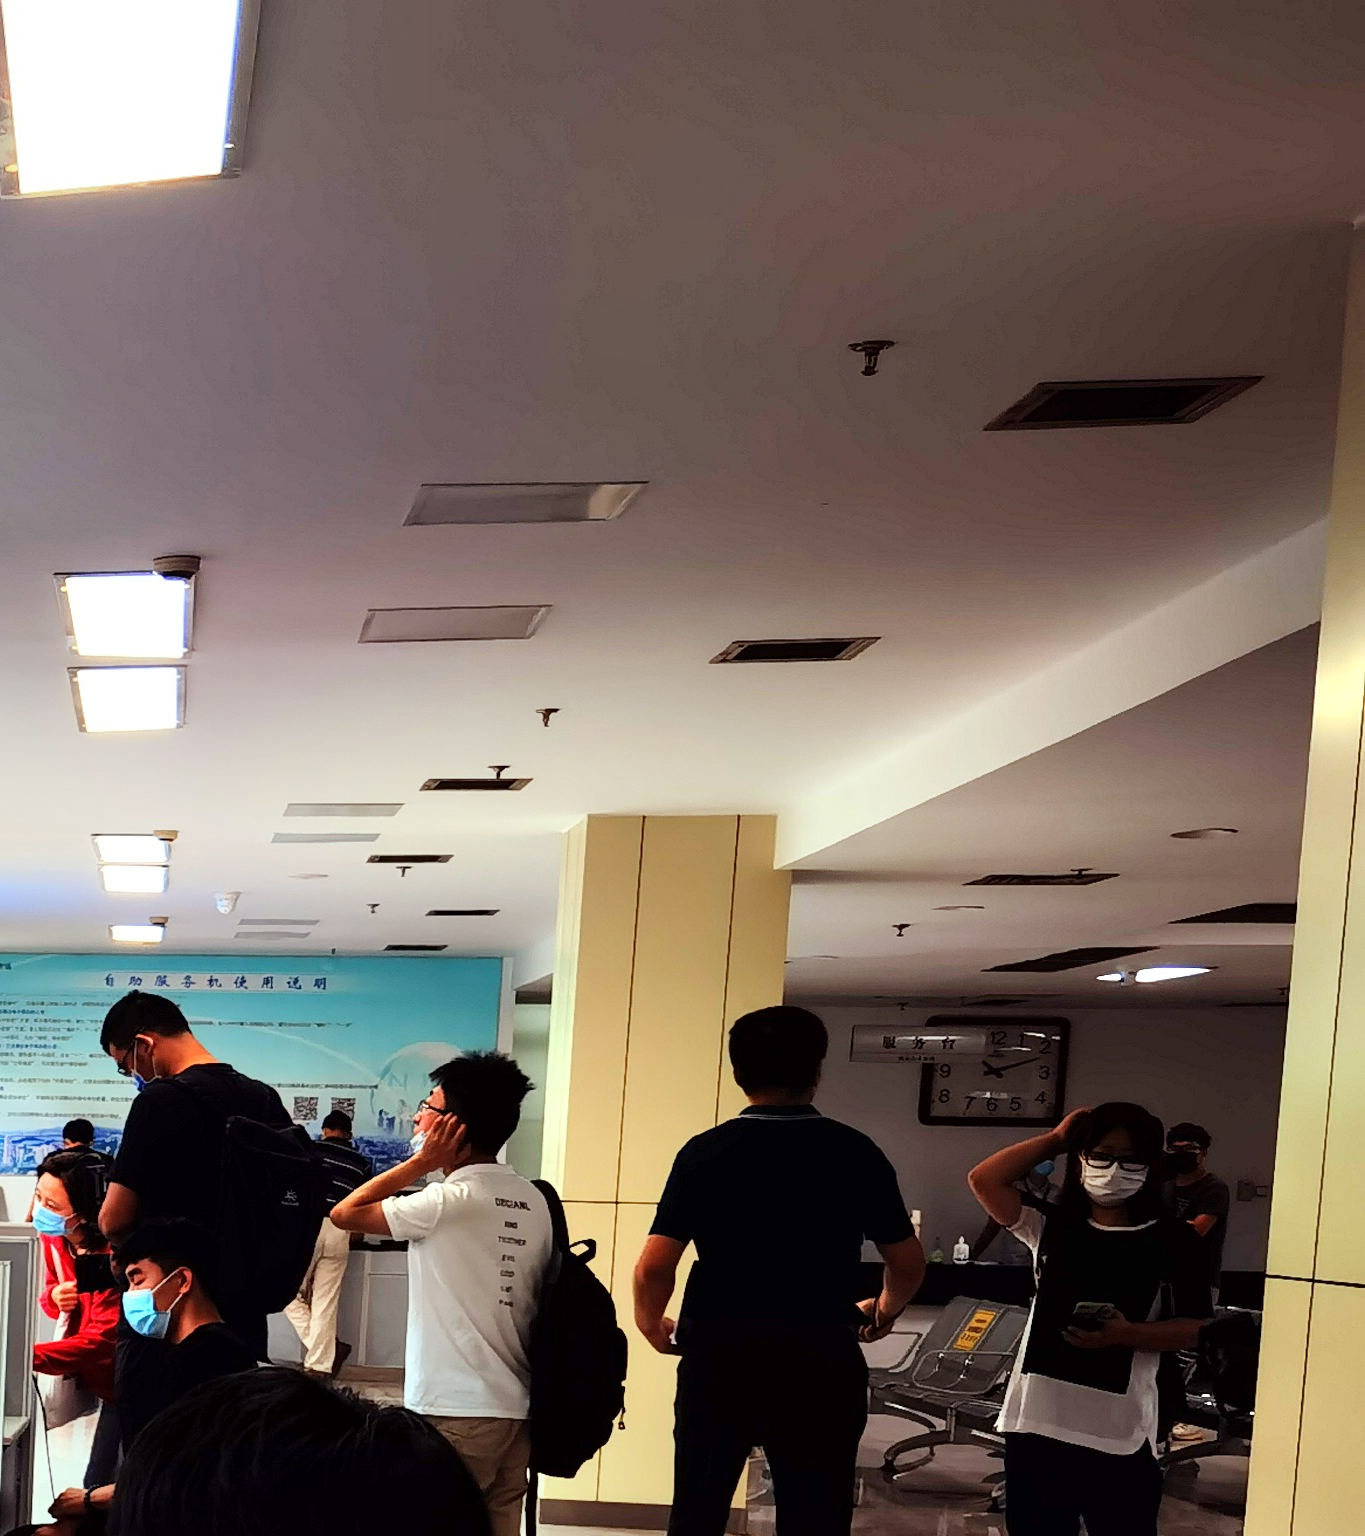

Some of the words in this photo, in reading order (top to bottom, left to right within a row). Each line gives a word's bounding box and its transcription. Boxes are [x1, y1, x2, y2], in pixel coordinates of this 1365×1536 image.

[103, 972, 328, 991] 自助服务机使用说明
[990, 1031, 1007, 1046] 12
[939, 1063, 952, 1079] 9
[1038, 1065, 1050, 1080] 3
[938, 1088, 951, 1104] 8
[1009, 1096, 1022, 1111] 5
[1034, 1090, 1048, 1105] 4
[986, 1096, 998, 1112] 6
